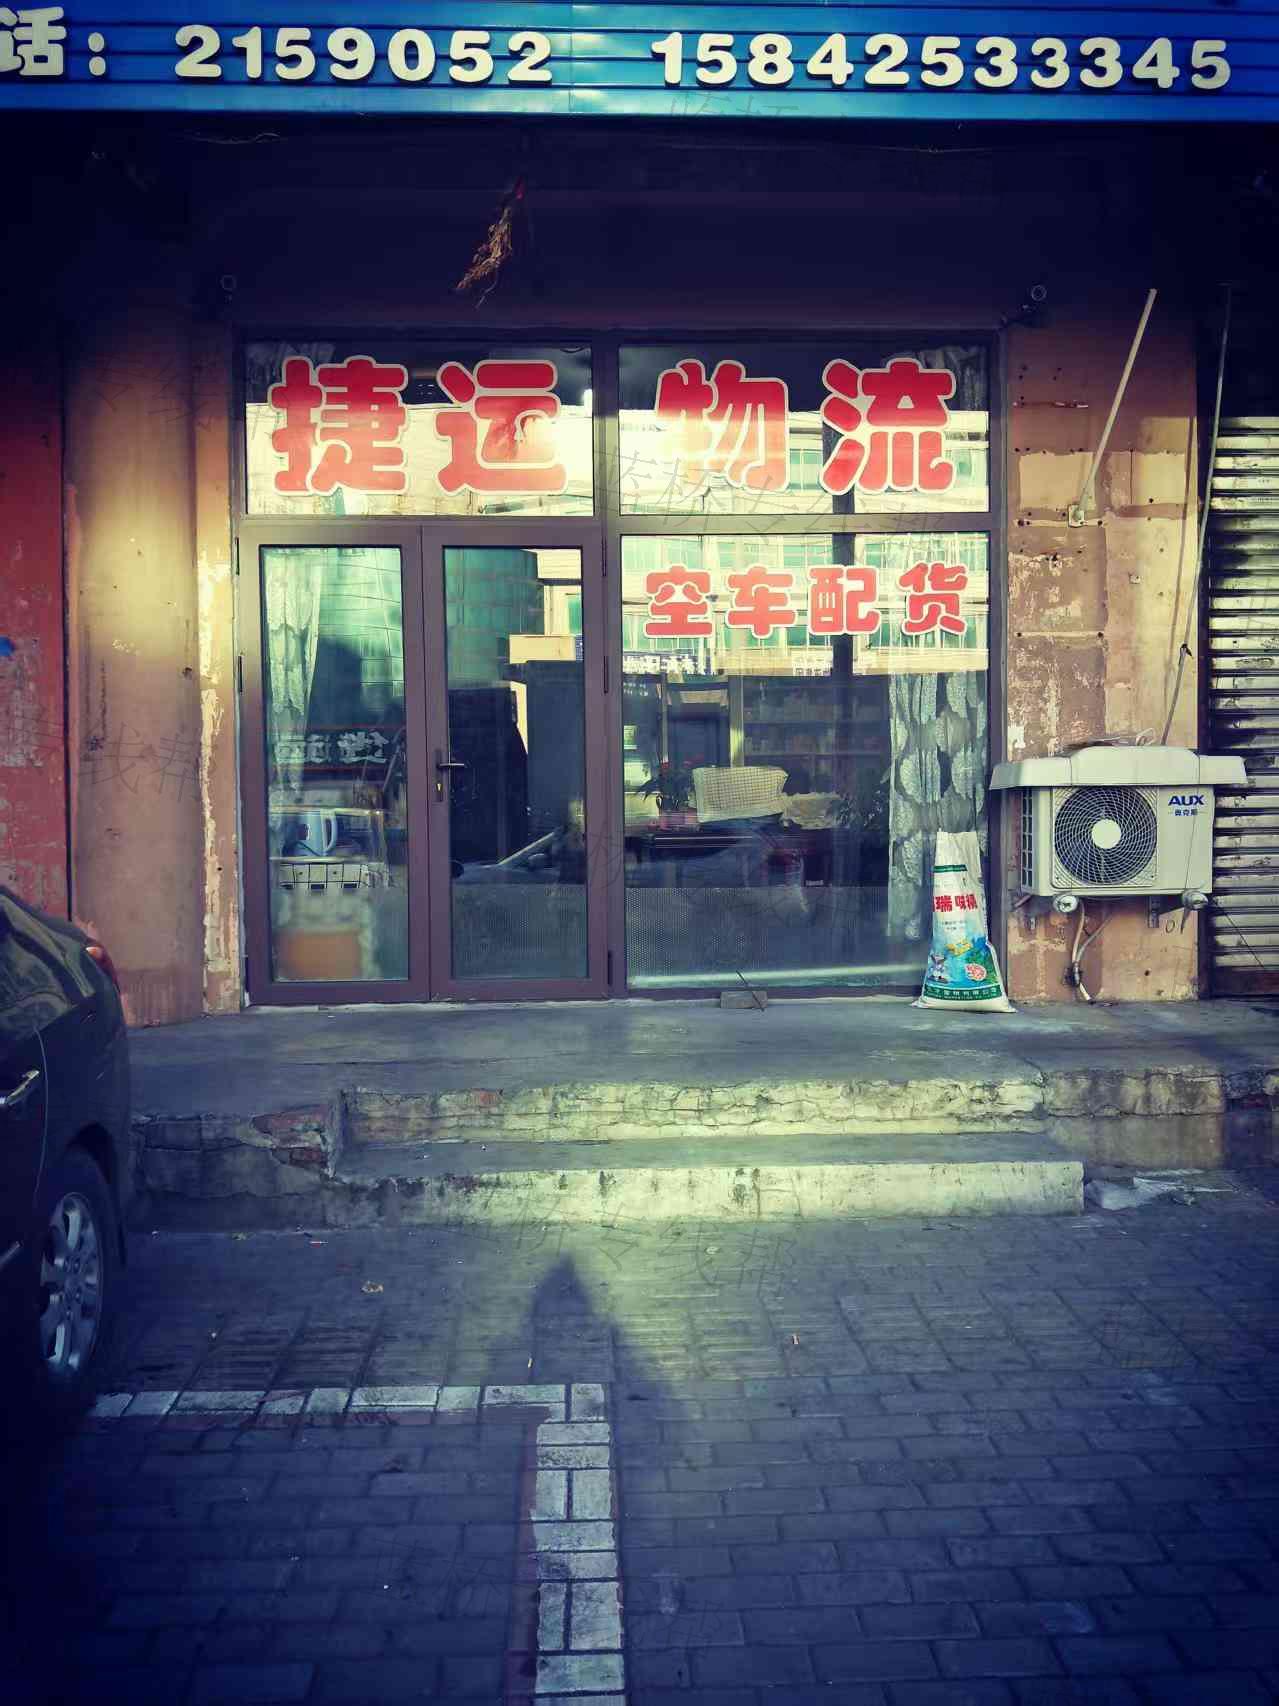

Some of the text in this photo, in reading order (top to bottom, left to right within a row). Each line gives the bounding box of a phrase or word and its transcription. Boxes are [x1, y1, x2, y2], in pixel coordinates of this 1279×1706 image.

[175, 24, 553, 83] 2159052
[651, 32, 1231, 89] 15842533345
[642, 561, 968, 639] 空车配货
[1168, 795, 1204, 806] AUX
